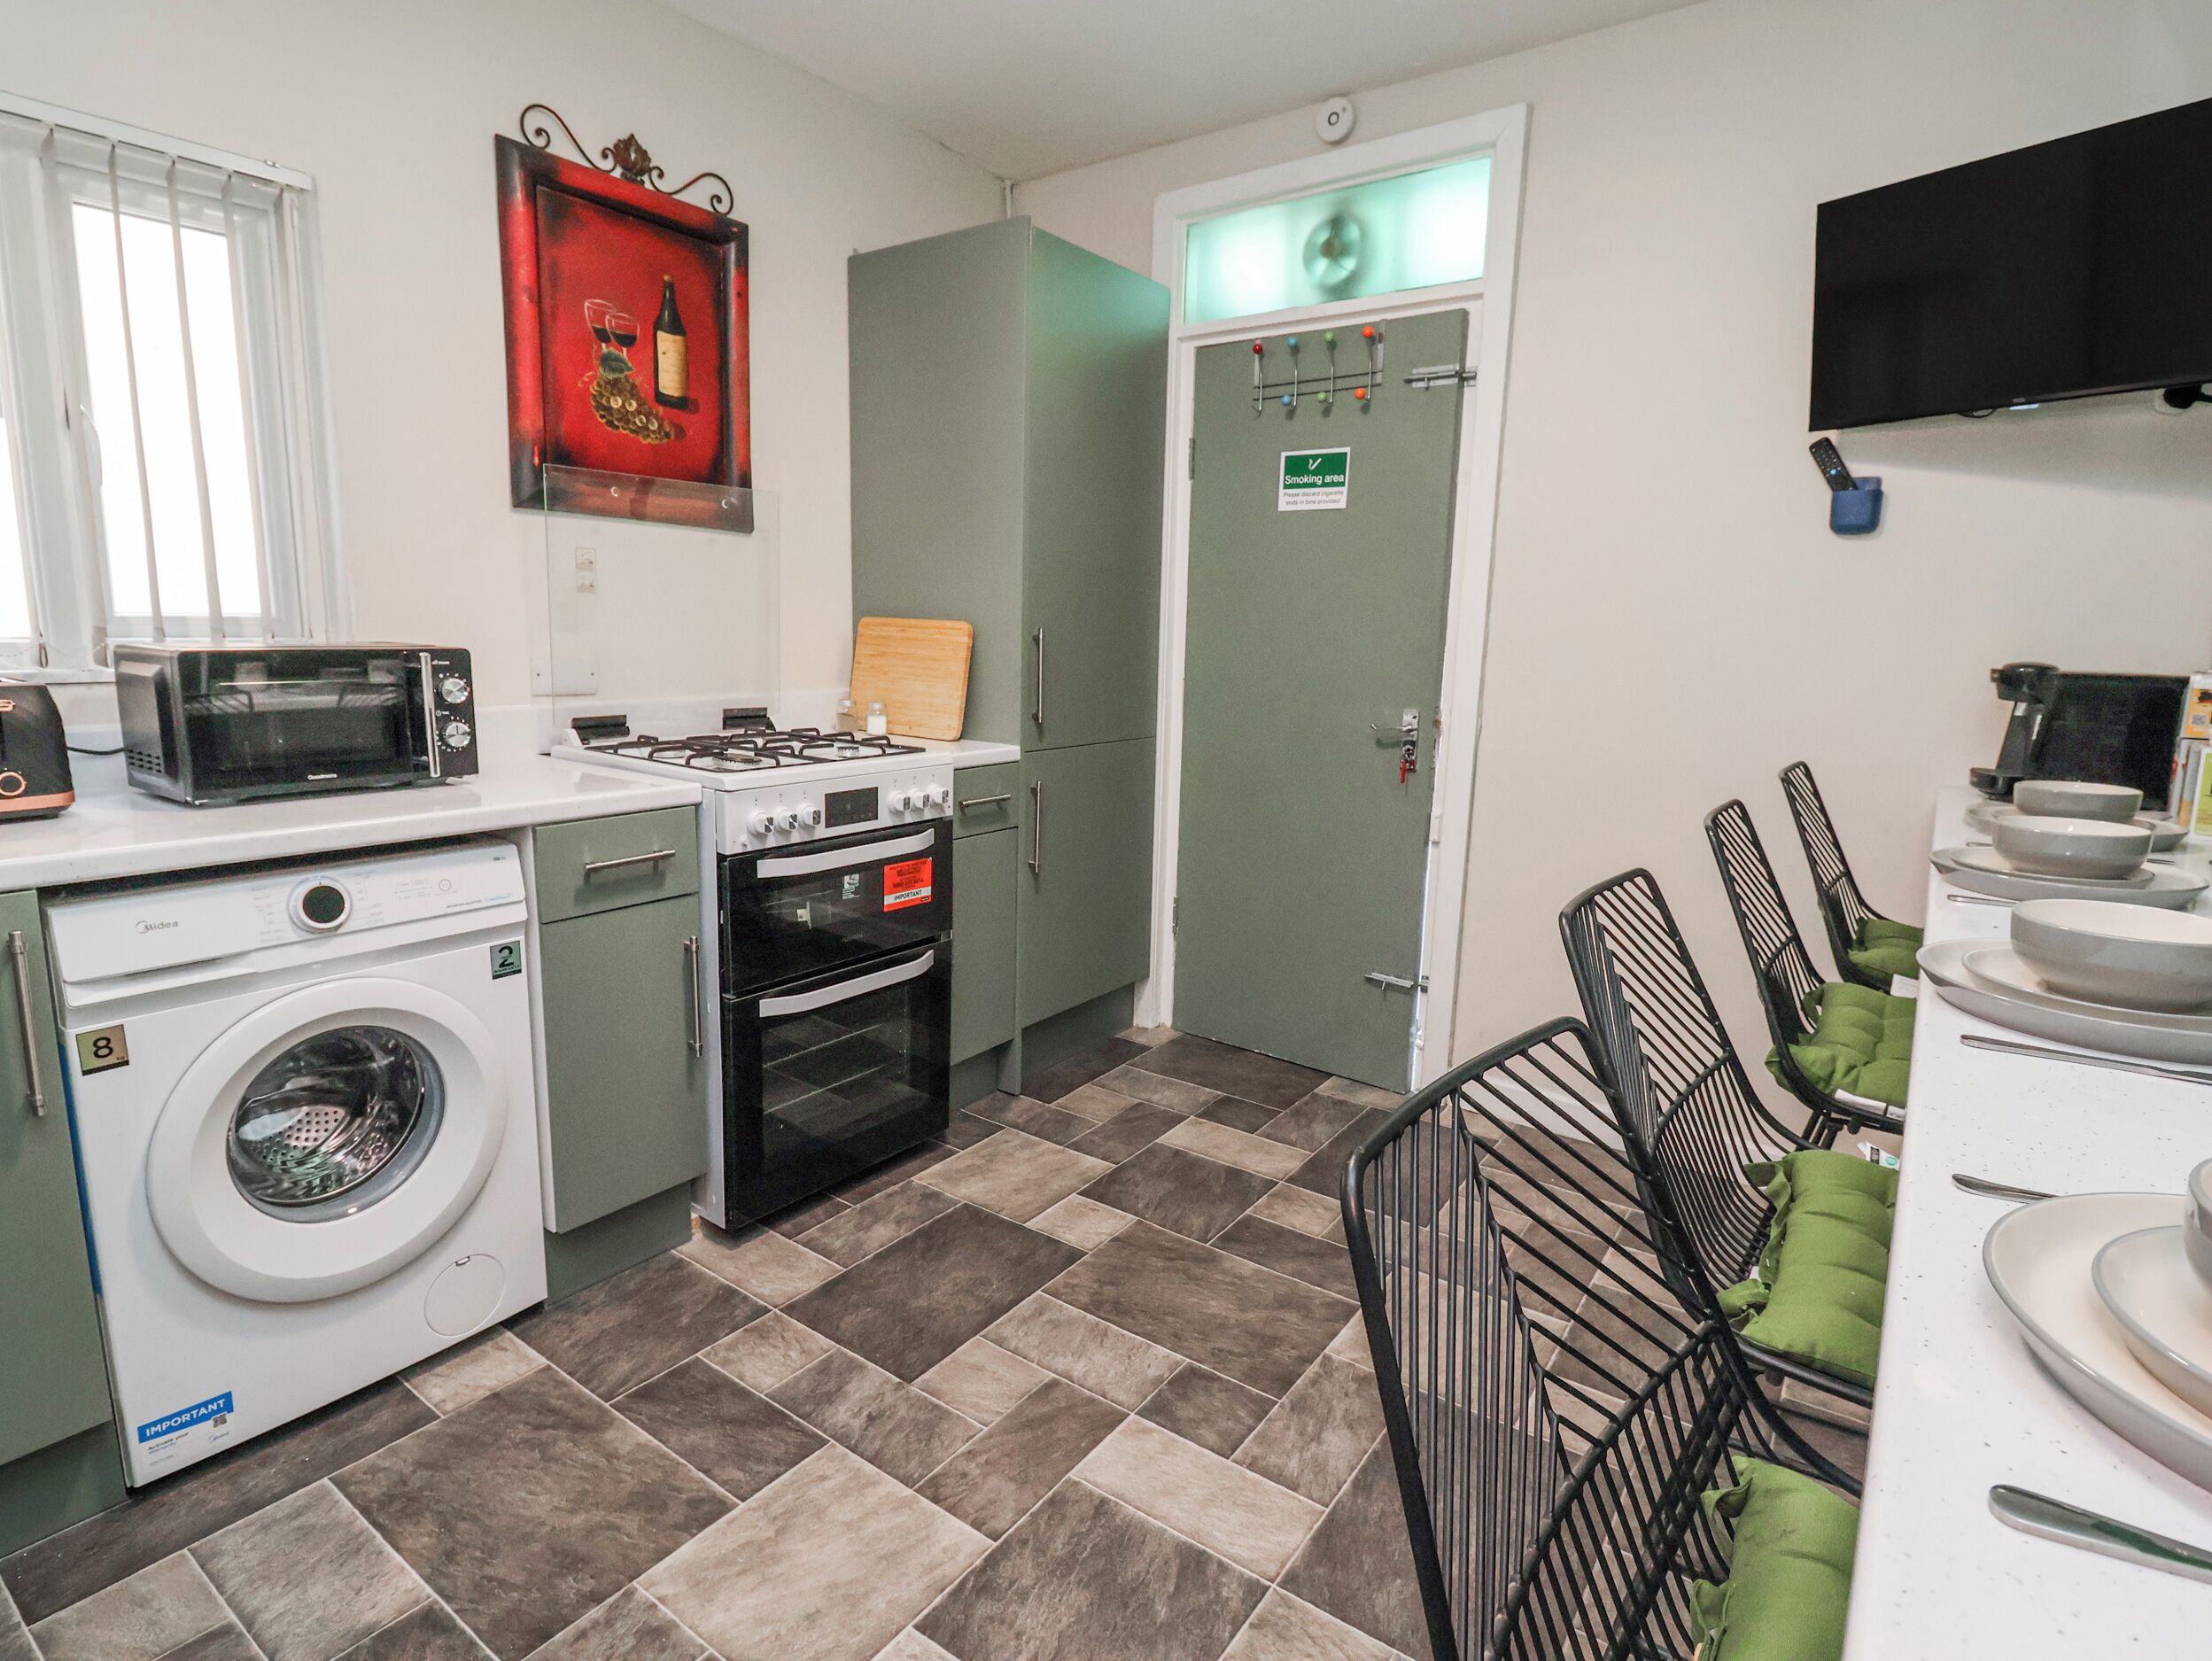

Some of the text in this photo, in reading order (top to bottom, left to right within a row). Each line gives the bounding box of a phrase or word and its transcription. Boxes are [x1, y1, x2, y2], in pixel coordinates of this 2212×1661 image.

[1285, 474, 1345, 485] Smoking area
[894, 889, 922, 901] IMPORTANT
[136, 920, 179, 933] Midea
[498, 945, 514, 968] 2
[93, 1036, 113, 1059] 8
[145, 1398, 226, 1437] IMPORTANT
[148, 1437, 175, 1450] Activate
